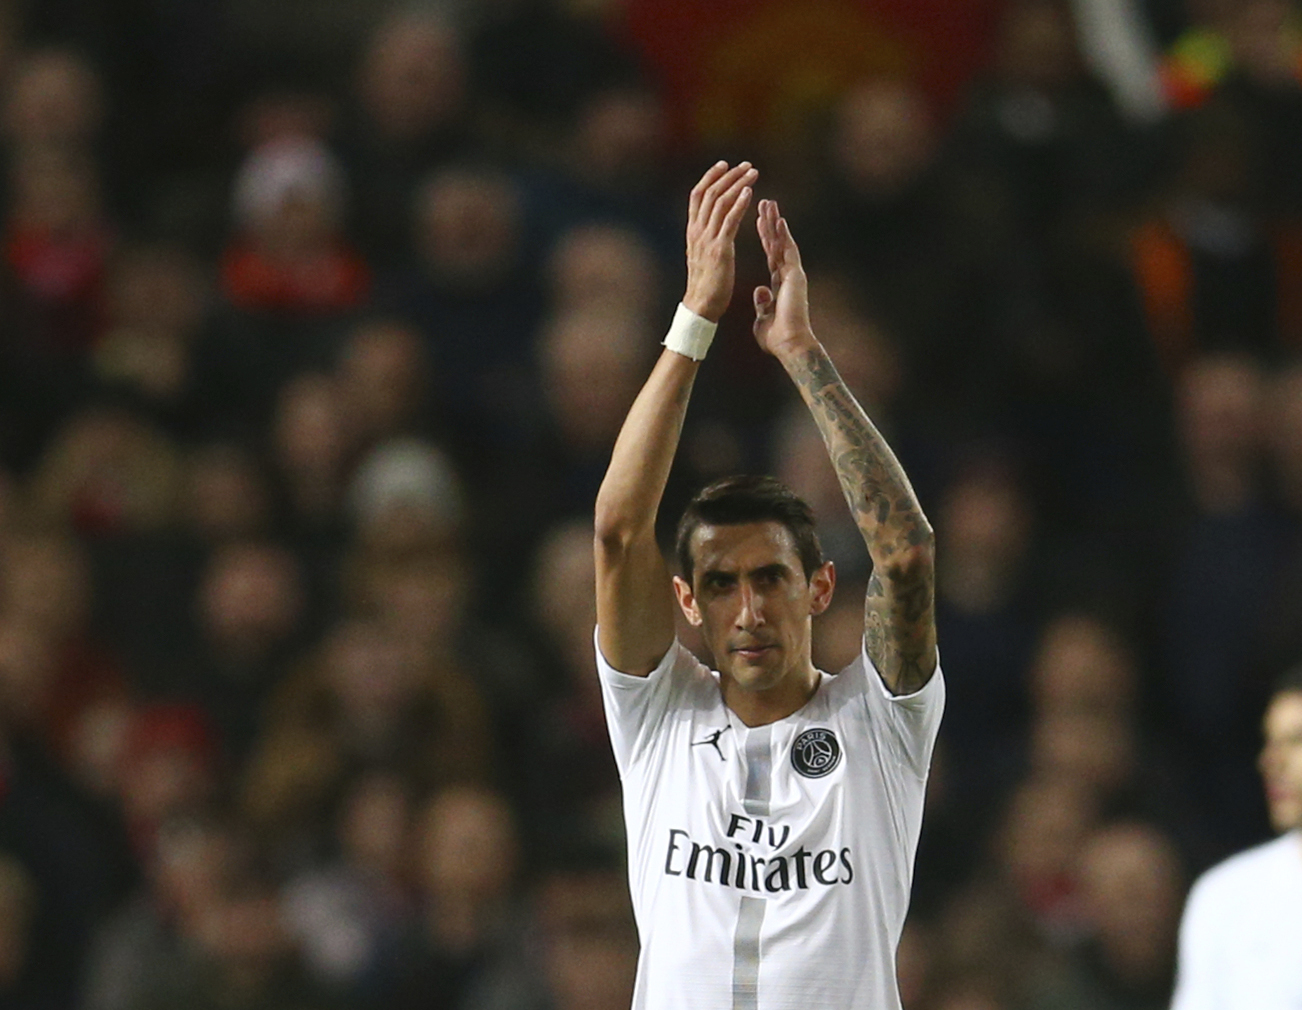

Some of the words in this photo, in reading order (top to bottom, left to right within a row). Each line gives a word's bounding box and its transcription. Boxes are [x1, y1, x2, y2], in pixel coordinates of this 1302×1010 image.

[796, 732, 826, 751] PARIS
[726, 813, 790, 850] Fly
[664, 829, 854, 894] Emirates
